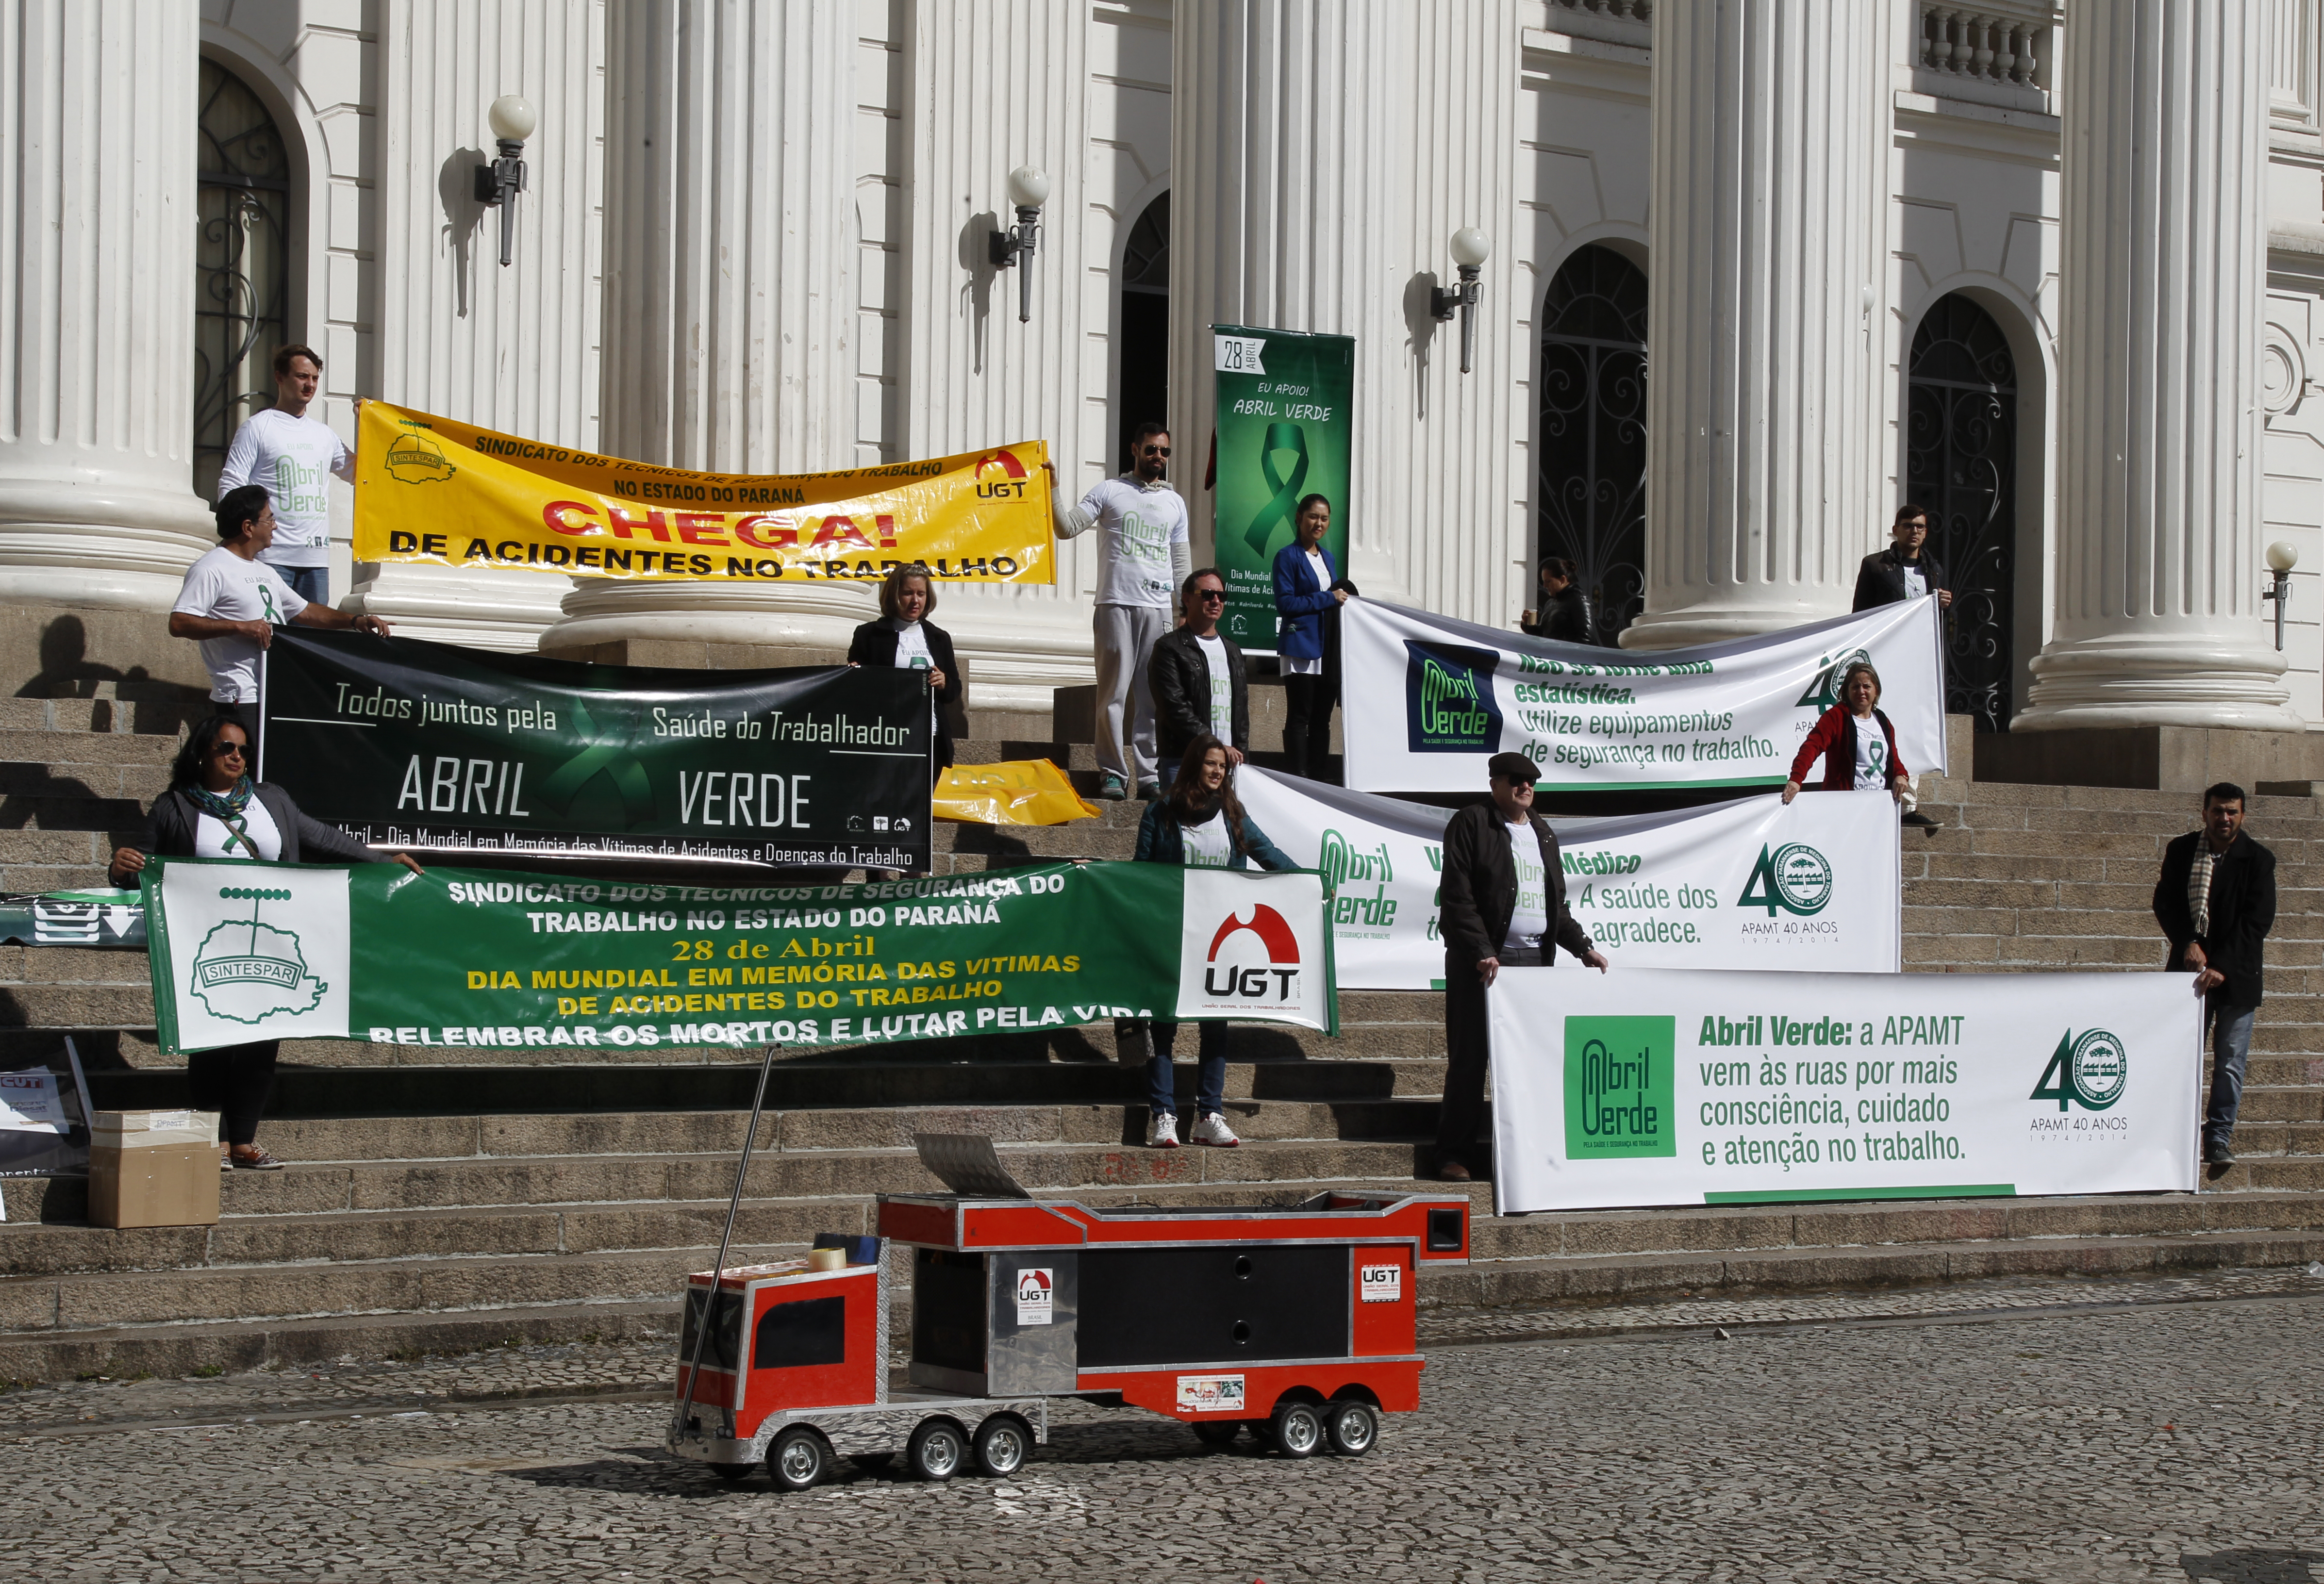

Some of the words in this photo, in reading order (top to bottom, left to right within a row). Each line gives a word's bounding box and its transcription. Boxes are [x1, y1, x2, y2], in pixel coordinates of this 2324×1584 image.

[1224, 341, 1242, 369] 28
[1245, 342, 1256, 369] ABRIL
[1258, 382, 1272, 393] EU
[1275, 383, 1310, 396] APOIO!
[1233, 399, 1278, 416] ABRIL
[1286, 403, 1333, 422] VERDE
[395, 454, 439, 465] SINTESPAR
[475, 436, 569, 462] SINDICATO
[572, 454, 610, 467] DOS
[615, 462, 701, 479] TÉCNICOS
[702, 474, 729, 484] DE
[831, 470, 856, 478] DO
[859, 462, 943, 478] TRABALHO
[614, 480, 637, 496] NO
[643, 482, 706, 501] ESTADO
[711, 487, 734, 503] DO
[739, 485, 806, 504] PARANÁ
[976, 481, 1027, 498] UGT
[543, 500, 897, 551] CHEGA!
[390, 530, 448, 557] DE
[464, 538, 713, 575] ACIDENTES
[728, 557, 783, 578] NO
[1231, 569, 1243, 579] Dia
[1245, 570, 1271, 581] Mundial
[1252, 584, 1261, 594] de
[1518, 653, 1564, 675] Não
[1568, 661, 1597, 676] se
[1662, 660, 1714, 675] uma
[336, 682, 412, 719] Todos
[418, 694, 497, 727] juntos
[507, 701, 556, 734] pela
[1514, 681, 1636, 705] estatística.
[653, 707, 727, 739] Saúde
[736, 711, 762, 740] do
[771, 711, 910, 746] Trabalhador
[1517, 709, 1582, 735] Utilize
[1590, 708, 1733, 739] equipamentos
[1521, 738, 1547, 764] de
[1555, 744, 1656, 770] segurança
[1662, 740, 1685, 762] no
[1692, 735, 1779, 761] trabalho.
[397, 755, 530, 816] ABRIL
[680, 771, 811, 828] VERDE
[388, 826, 410, 845] Dia
[417, 828, 472, 848] Mundial
[478, 837, 498, 849] em
[505, 833, 566, 852] Memória
[572, 836, 597, 852] das
[601, 837, 654, 855] Vítimas
[659, 840, 675, 856] de
[681, 841, 748, 860] Acidentes
[753, 848, 761, 861] e
[765, 843, 825, 865] Doenças
[829, 845, 847, 863] do
[851, 846, 913, 866] Trabalho
[1560, 851, 1642, 875] Médico
[448, 881, 599, 906] SINDICATO
[610, 885, 668, 902] DOS
[820, 885, 859, 900] DE
[862, 876, 1020, 901] SEGURANÇA
[1030, 873, 1065, 895] DO
[1333, 884, 1397, 926] erde
[1579, 883, 1596, 908] A
[1602, 881, 1670, 909] saúde
[1678, 883, 1718, 909] dos
[527, 910, 678, 933] TRABALHO
[686, 909, 726, 931] NO
[734, 908, 840, 930] ESTADO
[850, 907, 887, 927] DO
[895, 898, 1001, 927] PARANÁ
[1741, 922, 1779, 935] APAMT
[1783, 922, 1798, 935] 40
[1802, 922, 1838, 934] ANOS
[1592, 916, 1702, 948] agradece.
[671, 940, 714, 961] 28
[727, 939, 770, 960] de
[779, 935, 876, 959] Abril
[208, 962, 293, 982] SINTESPAR
[467, 971, 522, 990] DIA
[531, 969, 678, 989] MUNDIAL
[688, 968, 733, 987] EM
[741, 960, 888, 986] MEMÓRIA
[896, 960, 956, 981] DAS
[966, 955, 1081, 975] VITIMAS
[1205, 964, 1300, 1002] UGT
[557, 996, 599, 1015] DE
[608, 991, 786, 1013] ACIDENTES
[797, 989, 840, 1009] DO
[850, 979, 1003, 1007] TRABALHO
[369, 1025, 601, 1047] RELEMBRAR
[610, 1022, 660, 1046] OS
[670, 1020, 819, 1045] MORTOS
[830, 1018, 850, 1040] E
[863, 1010, 970, 1039] LUTAR
[976, 1006, 1066, 1029] PELA
[1698, 1015, 1762, 1046] Abril
[1770, 1015, 1853, 1046] Verde:
[1860, 1022, 1874, 1046] a
[1881, 1015, 1965, 1046] APAMT
[2, 1077, 39, 1088] CUT
[1698, 1062, 1750, 1087] vem
[1760, 1053, 1787, 1086] às
[1795, 1062, 1847, 1086] ruas
[1855, 1059, 1895, 1091] por
[1902, 1054, 1958, 1085] mais
[1699, 1092, 1850, 1129] consciência,
[1858, 1091, 1950, 1124] cuidado
[2029, 1118, 2070, 1131] APAMT
[2073, 1117, 2088, 1131] 40
[2092, 1117, 2128, 1131] ANOS
[1702, 1141, 1716, 1166] e
[1724, 1131, 1820, 1172] atenção
[1828, 1136, 1857, 1163] no
[1863, 1129, 1967, 1162] trabalho.
[1363, 1268, 1399, 1284] UGT
[1020, 1289, 1051, 1301] UGT
